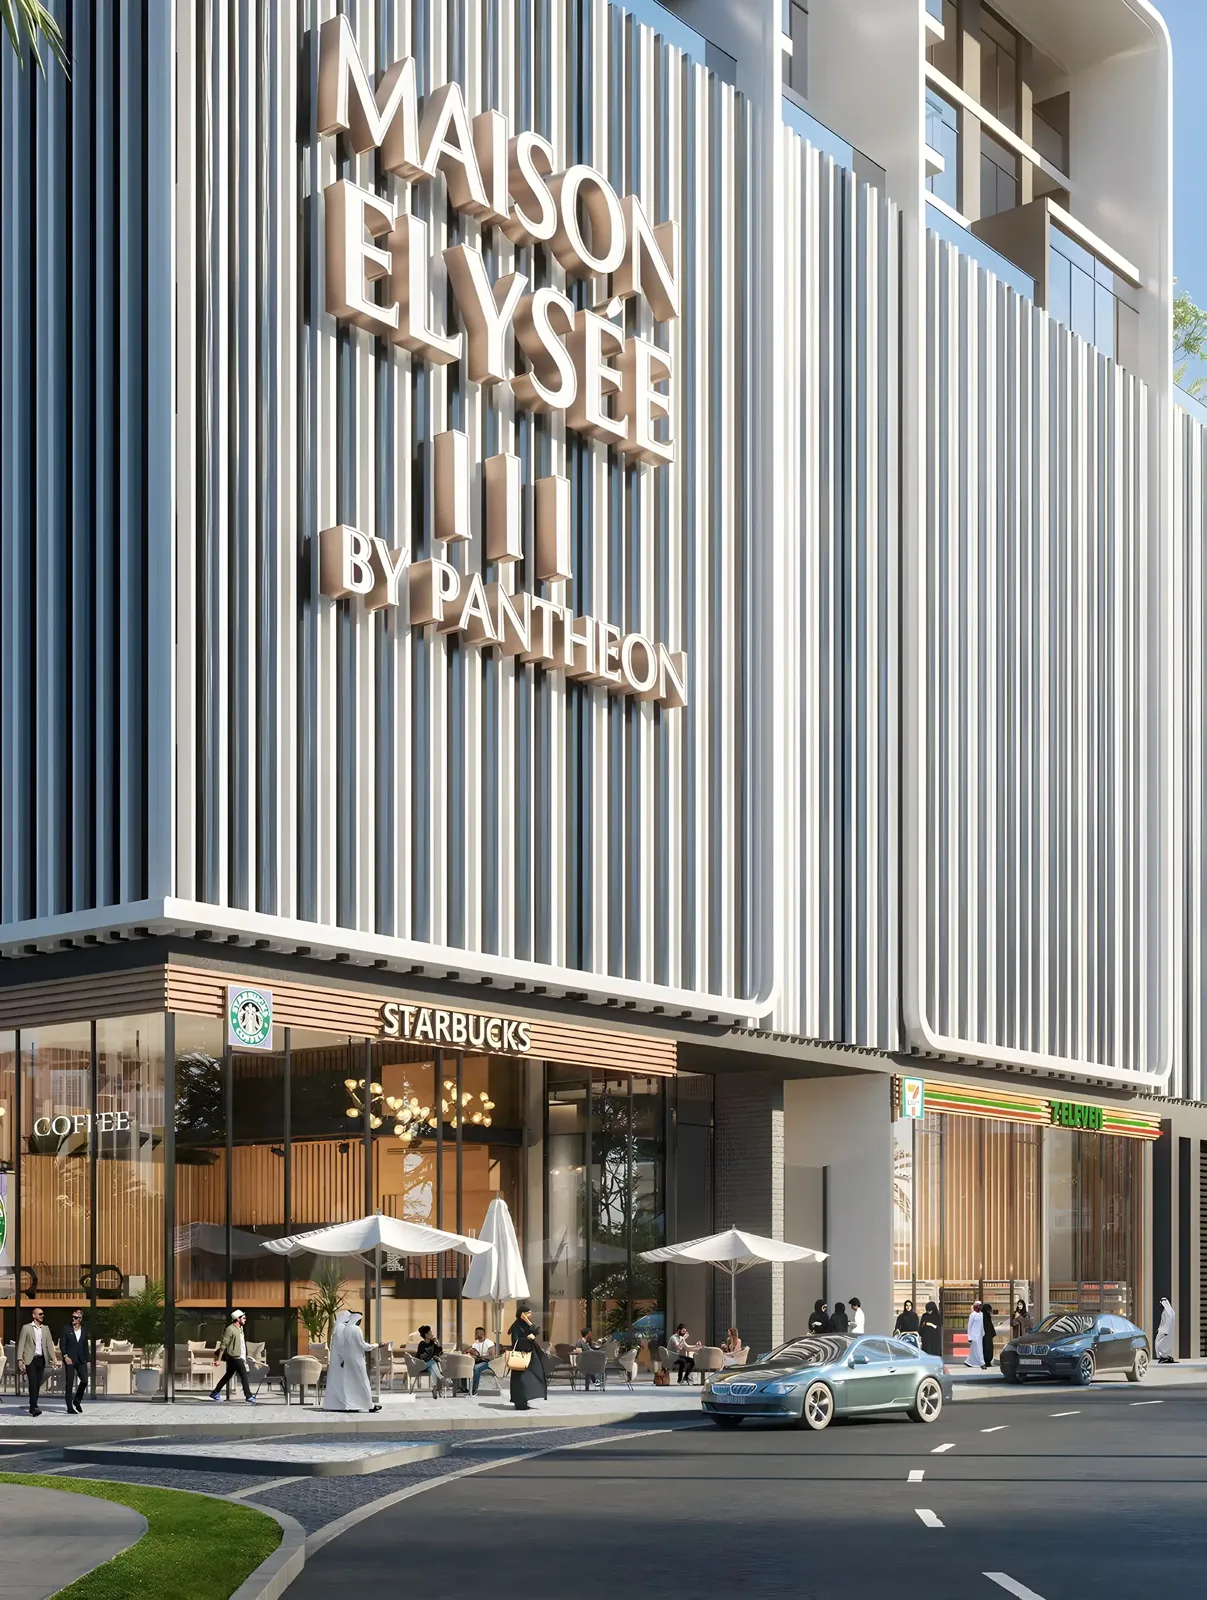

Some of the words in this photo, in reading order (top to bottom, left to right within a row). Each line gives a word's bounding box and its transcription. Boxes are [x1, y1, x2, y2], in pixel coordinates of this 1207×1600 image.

[330, 13, 681, 319] MAISON
[337, 178, 677, 464] ELYSÉE
[337, 523, 410, 608] BY
[425, 556, 688, 707] PANTHEON
[381, 1002, 532, 1053] STARBUCKS
